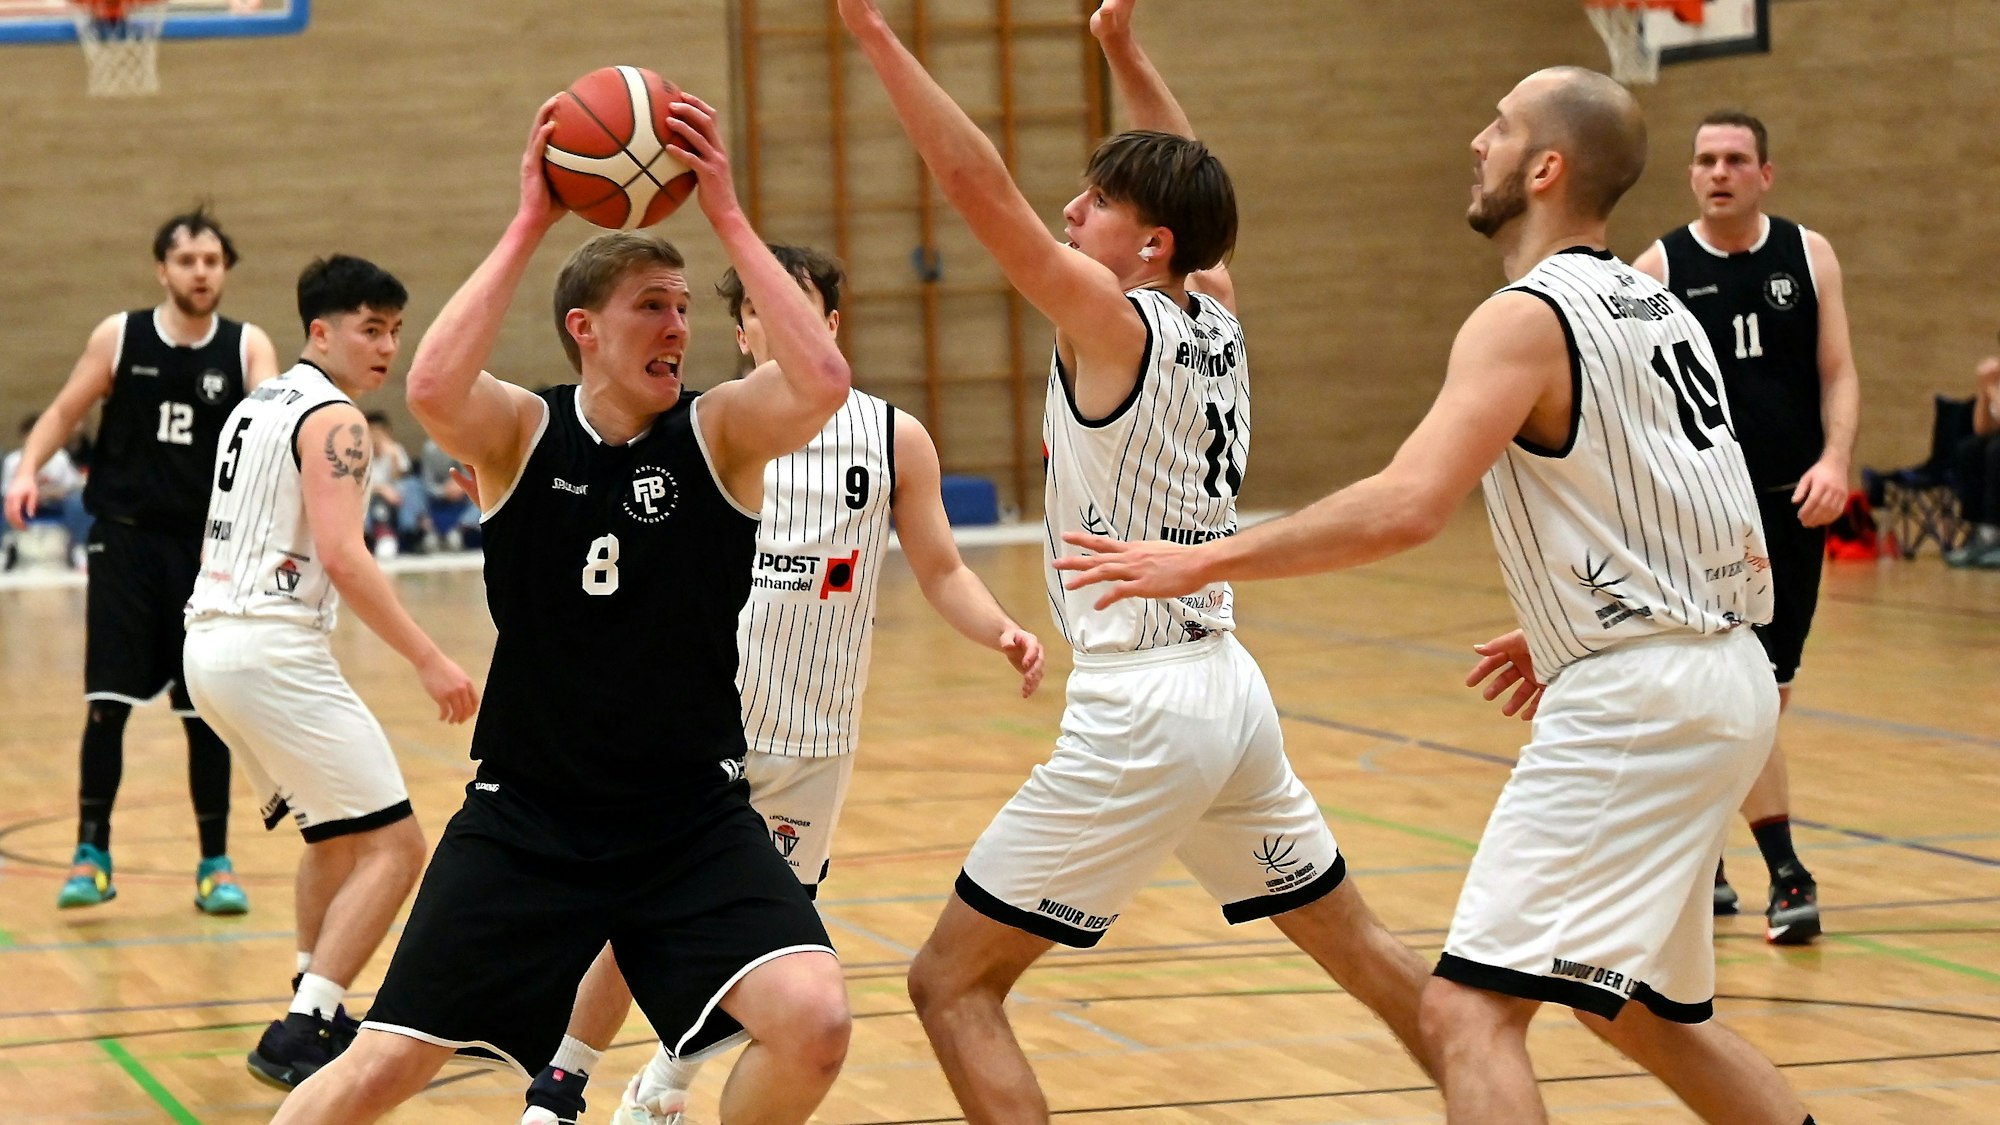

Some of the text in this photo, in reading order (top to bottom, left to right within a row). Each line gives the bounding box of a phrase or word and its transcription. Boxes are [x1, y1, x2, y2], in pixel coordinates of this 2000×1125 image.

[1732, 312, 1763, 360] 11
[1651, 340, 1728, 451] 14
[157, 400, 194, 446] 12
[218, 417, 253, 493] 5
[845, 466, 870, 510] 9
[582, 532, 620, 596] 8
[758, 552, 821, 575] POST
[1037, 898, 1085, 926] MUUUR
[1593, 967, 1624, 990] DER
